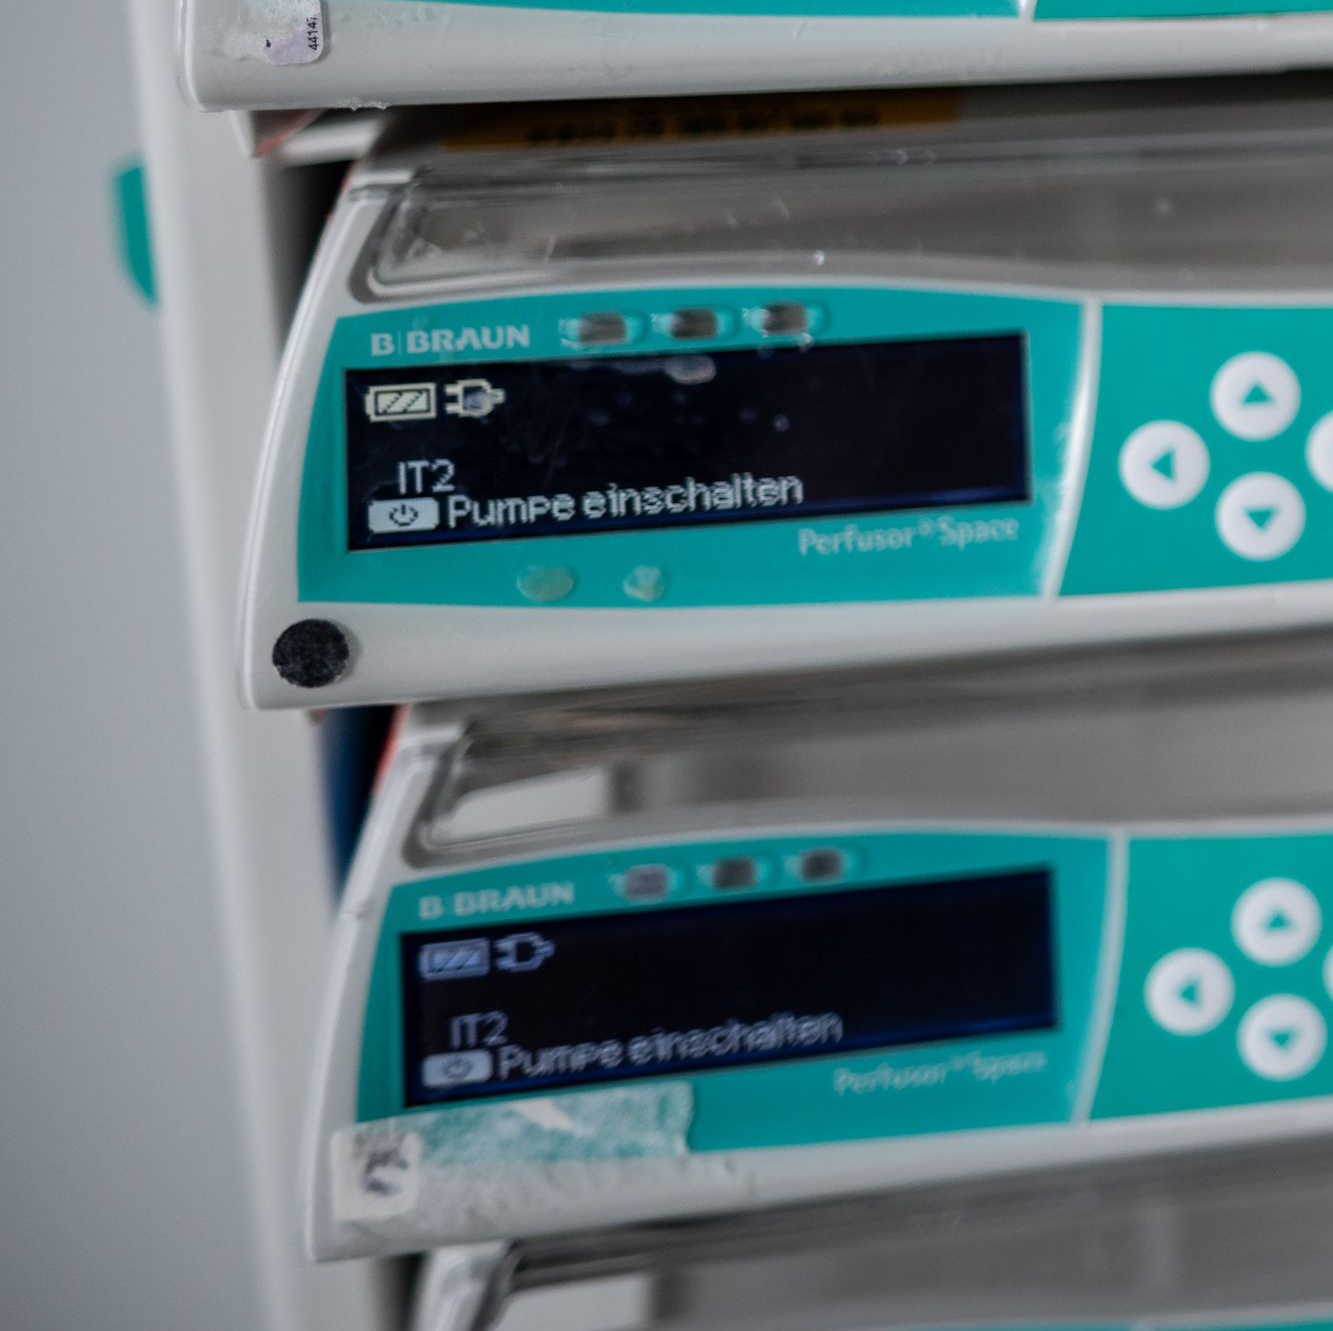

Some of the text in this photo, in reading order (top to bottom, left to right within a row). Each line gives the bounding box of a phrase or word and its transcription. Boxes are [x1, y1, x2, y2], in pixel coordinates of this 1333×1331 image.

[406, 324, 531, 354] BRAUN
[399, 458, 455, 494] IT2
[447, 472, 804, 529] Pumpe einschalten
[936, 515, 1020, 552] Space
[449, 1010, 508, 1048] IT2
[500, 1037, 626, 1078] Pumpe
